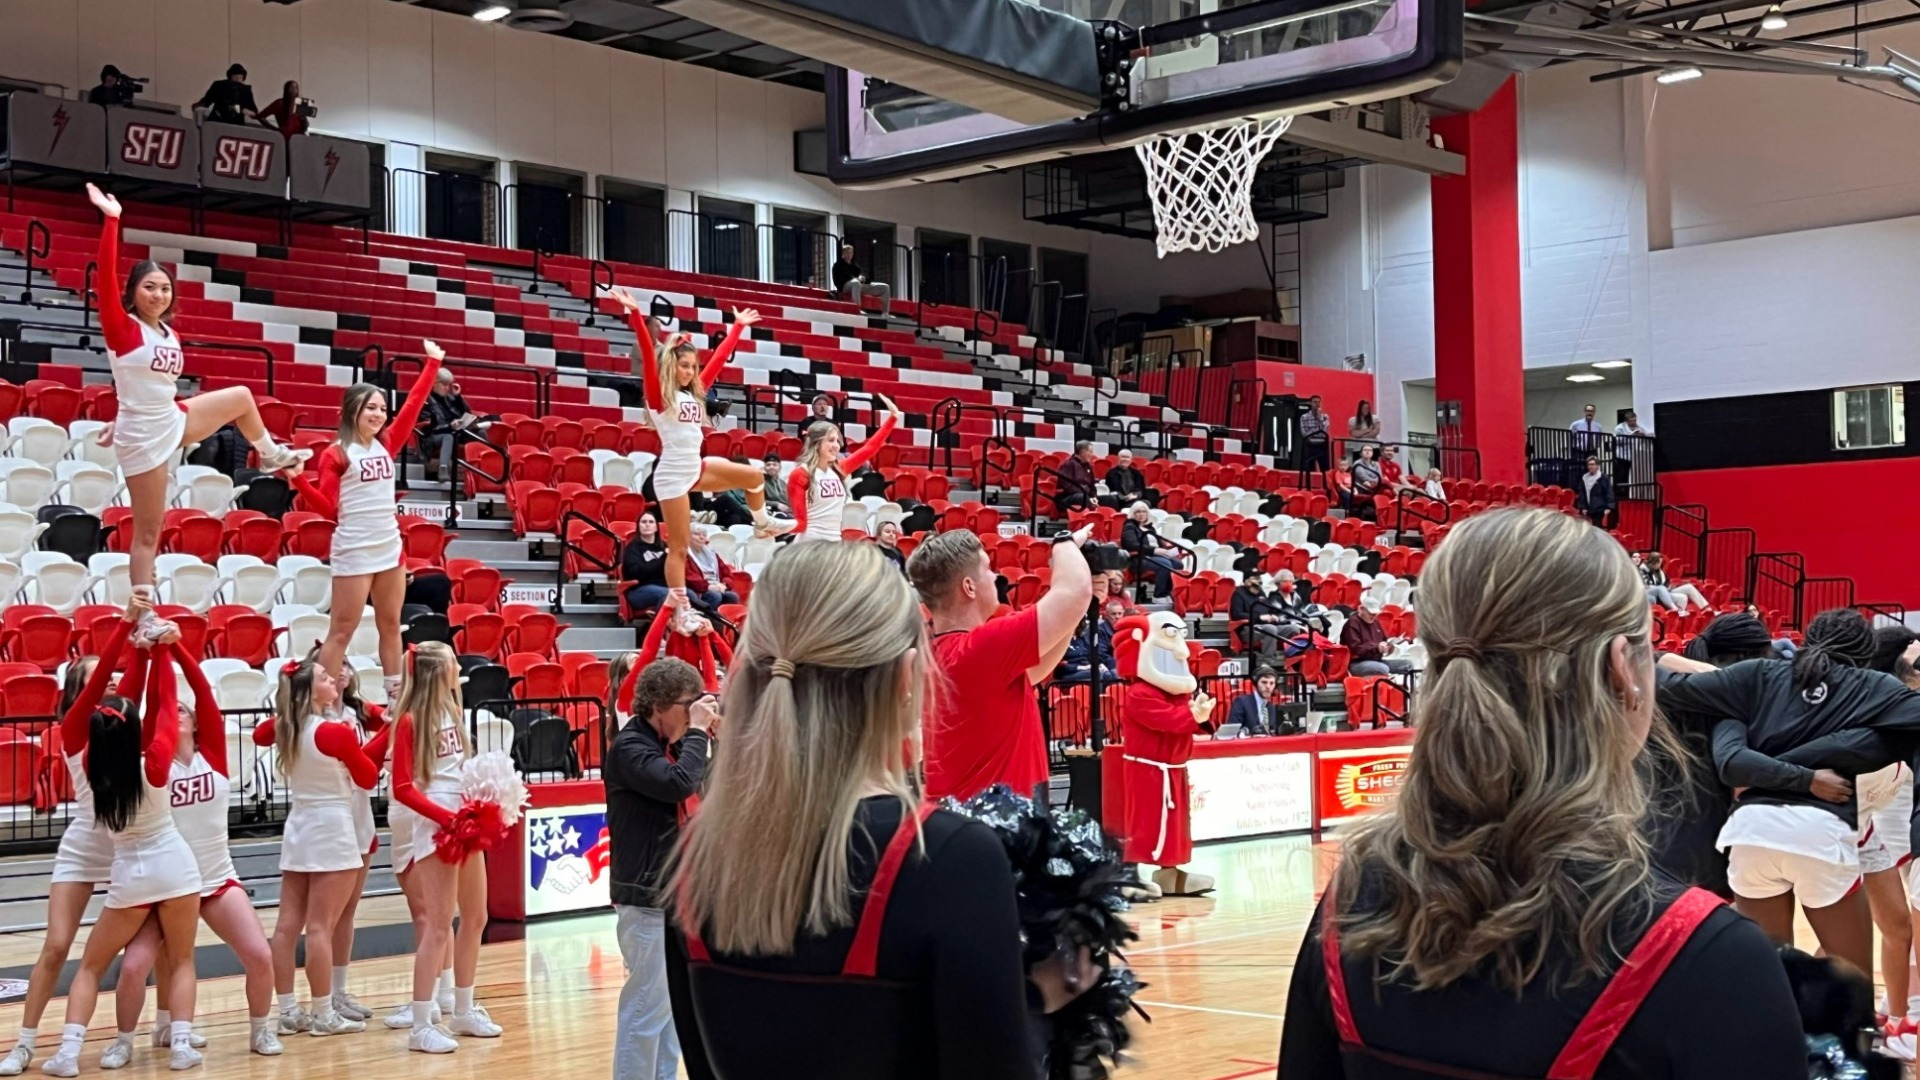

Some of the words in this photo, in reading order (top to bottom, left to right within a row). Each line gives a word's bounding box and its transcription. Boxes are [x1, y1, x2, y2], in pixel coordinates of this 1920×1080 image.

[122, 123, 185, 168] SFU
[213, 137, 273, 180] SFU
[151, 346, 183, 375] SFU
[361, 456, 394, 482] SFU
[820, 479, 845, 497] SFU
[409, 508, 443, 517] SECTION
[510, 591, 546, 601] SECTION
[171, 772, 215, 807] SFU
